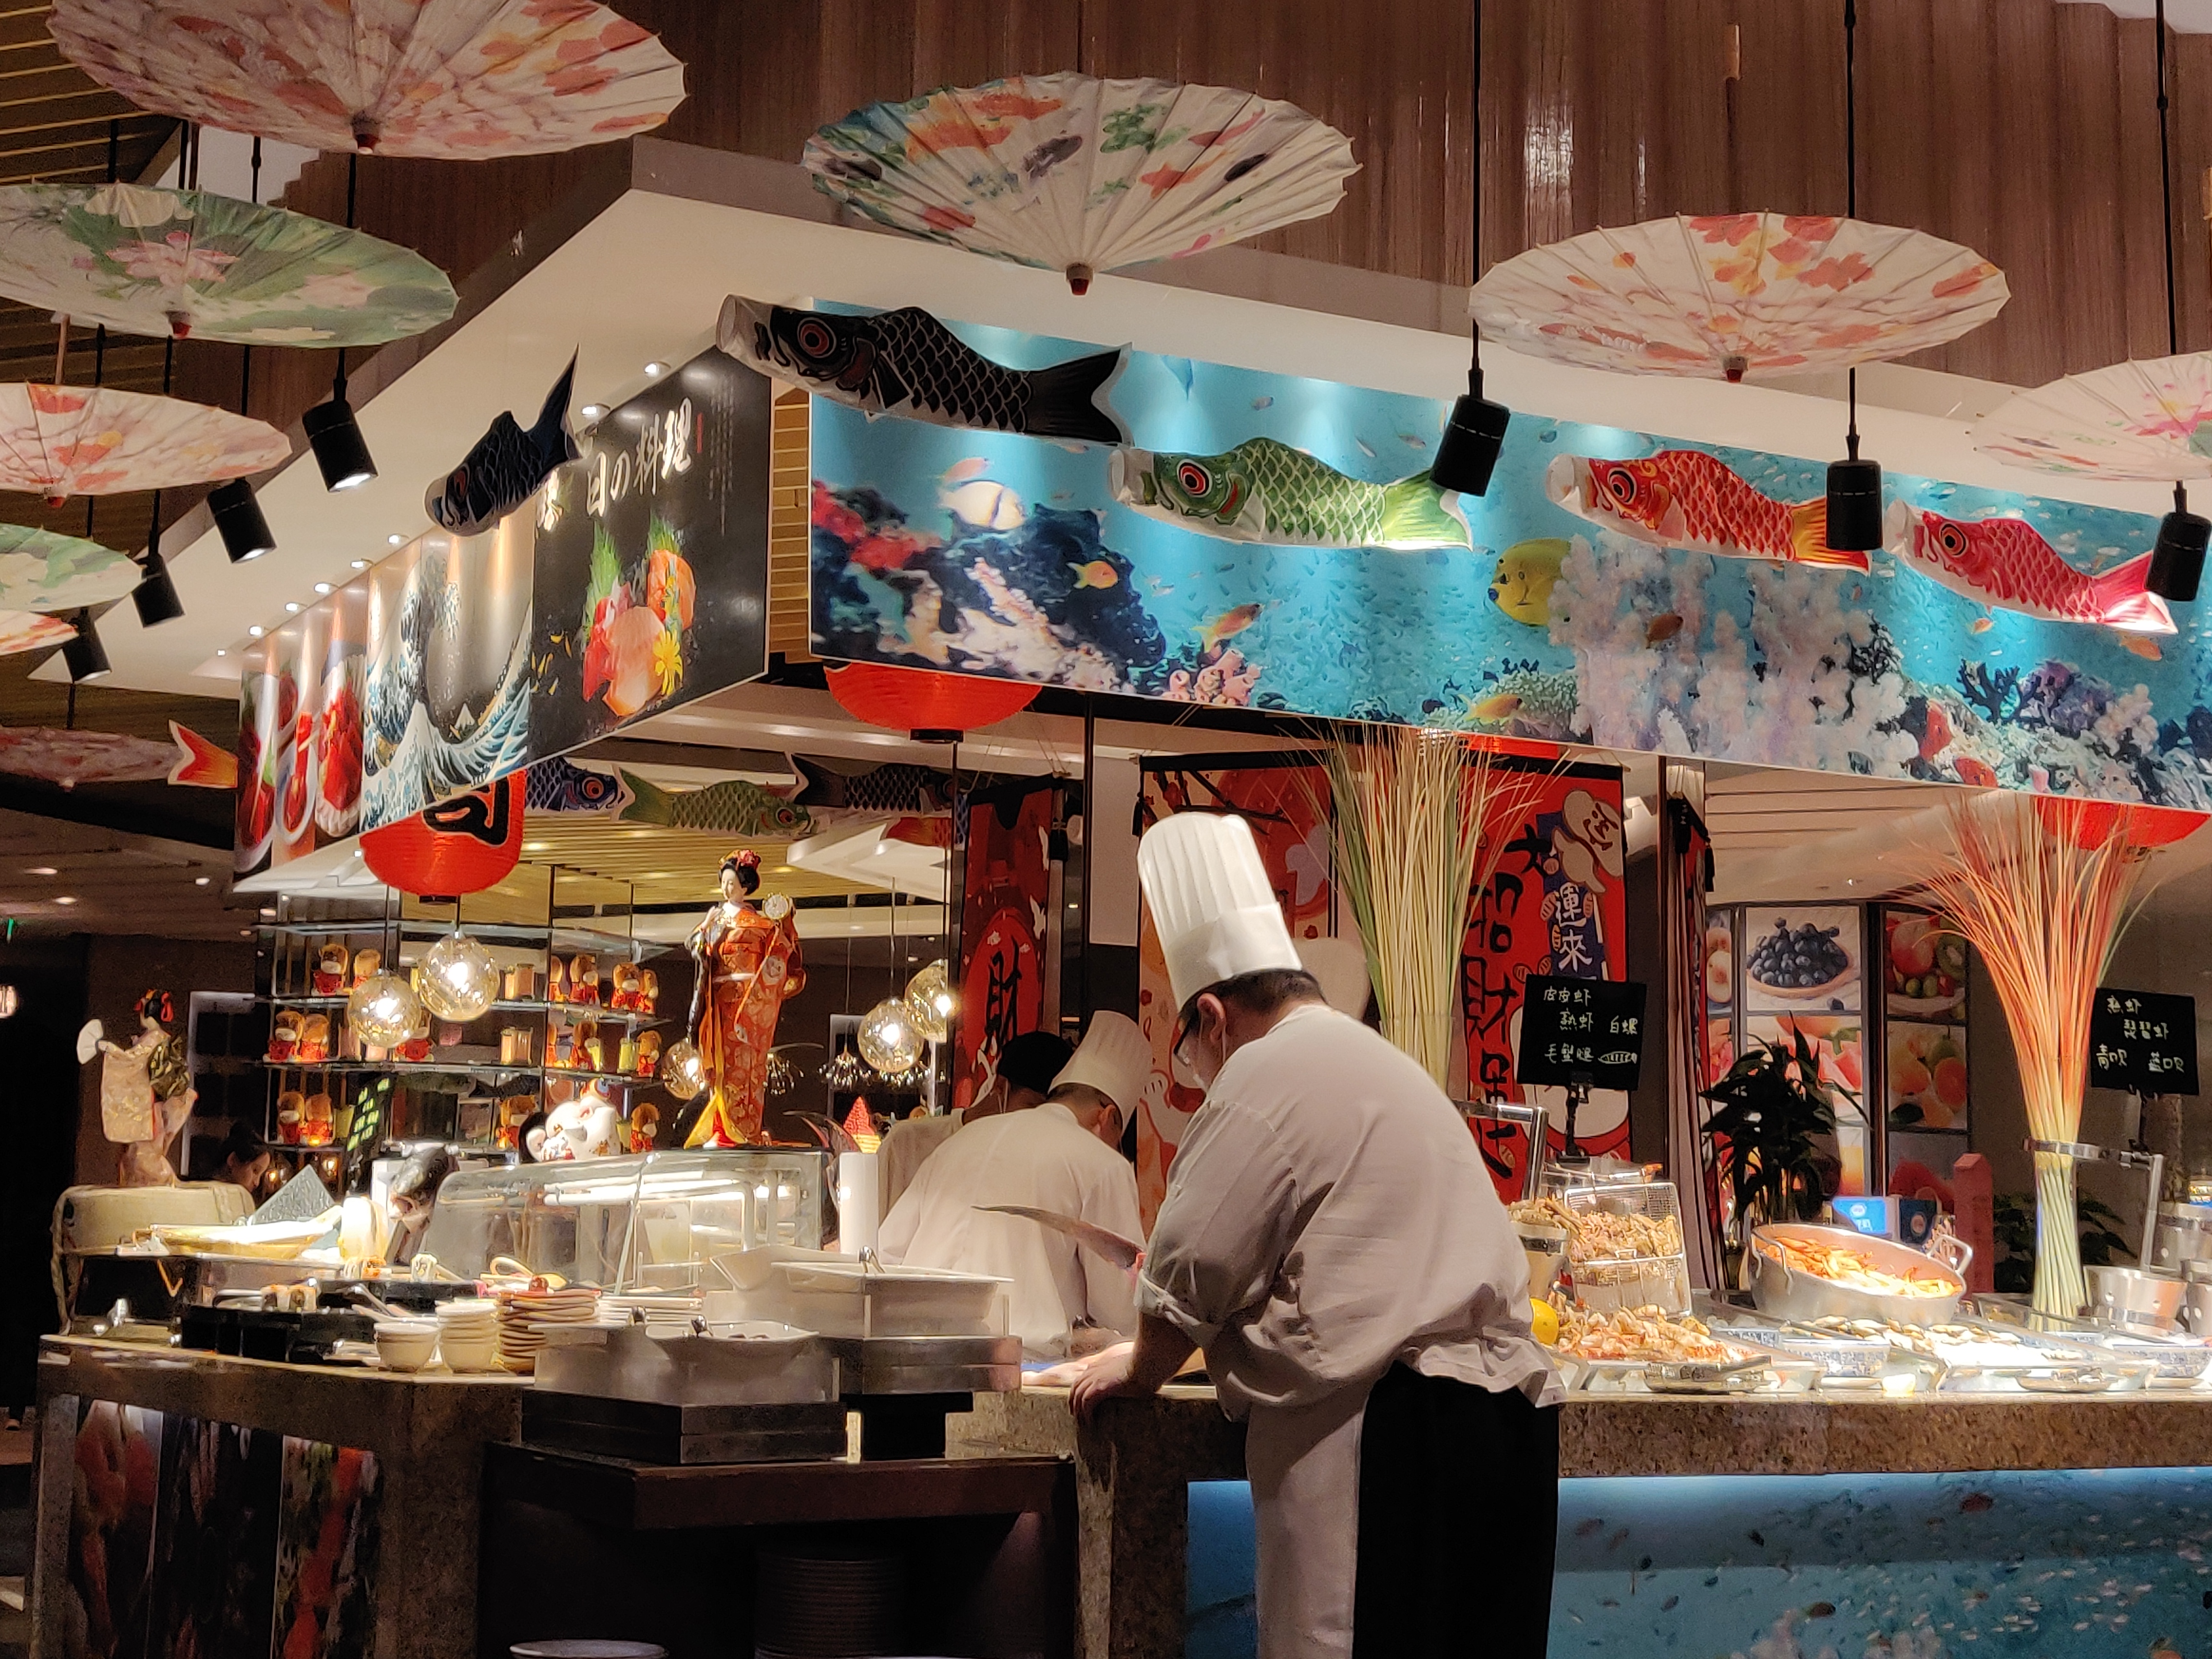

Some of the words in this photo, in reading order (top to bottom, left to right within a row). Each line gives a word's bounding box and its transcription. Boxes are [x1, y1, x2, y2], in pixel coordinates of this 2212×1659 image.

[1555, 882, 1597, 980] 運來
[1543, 986, 1591, 1006] 皮皮虾
